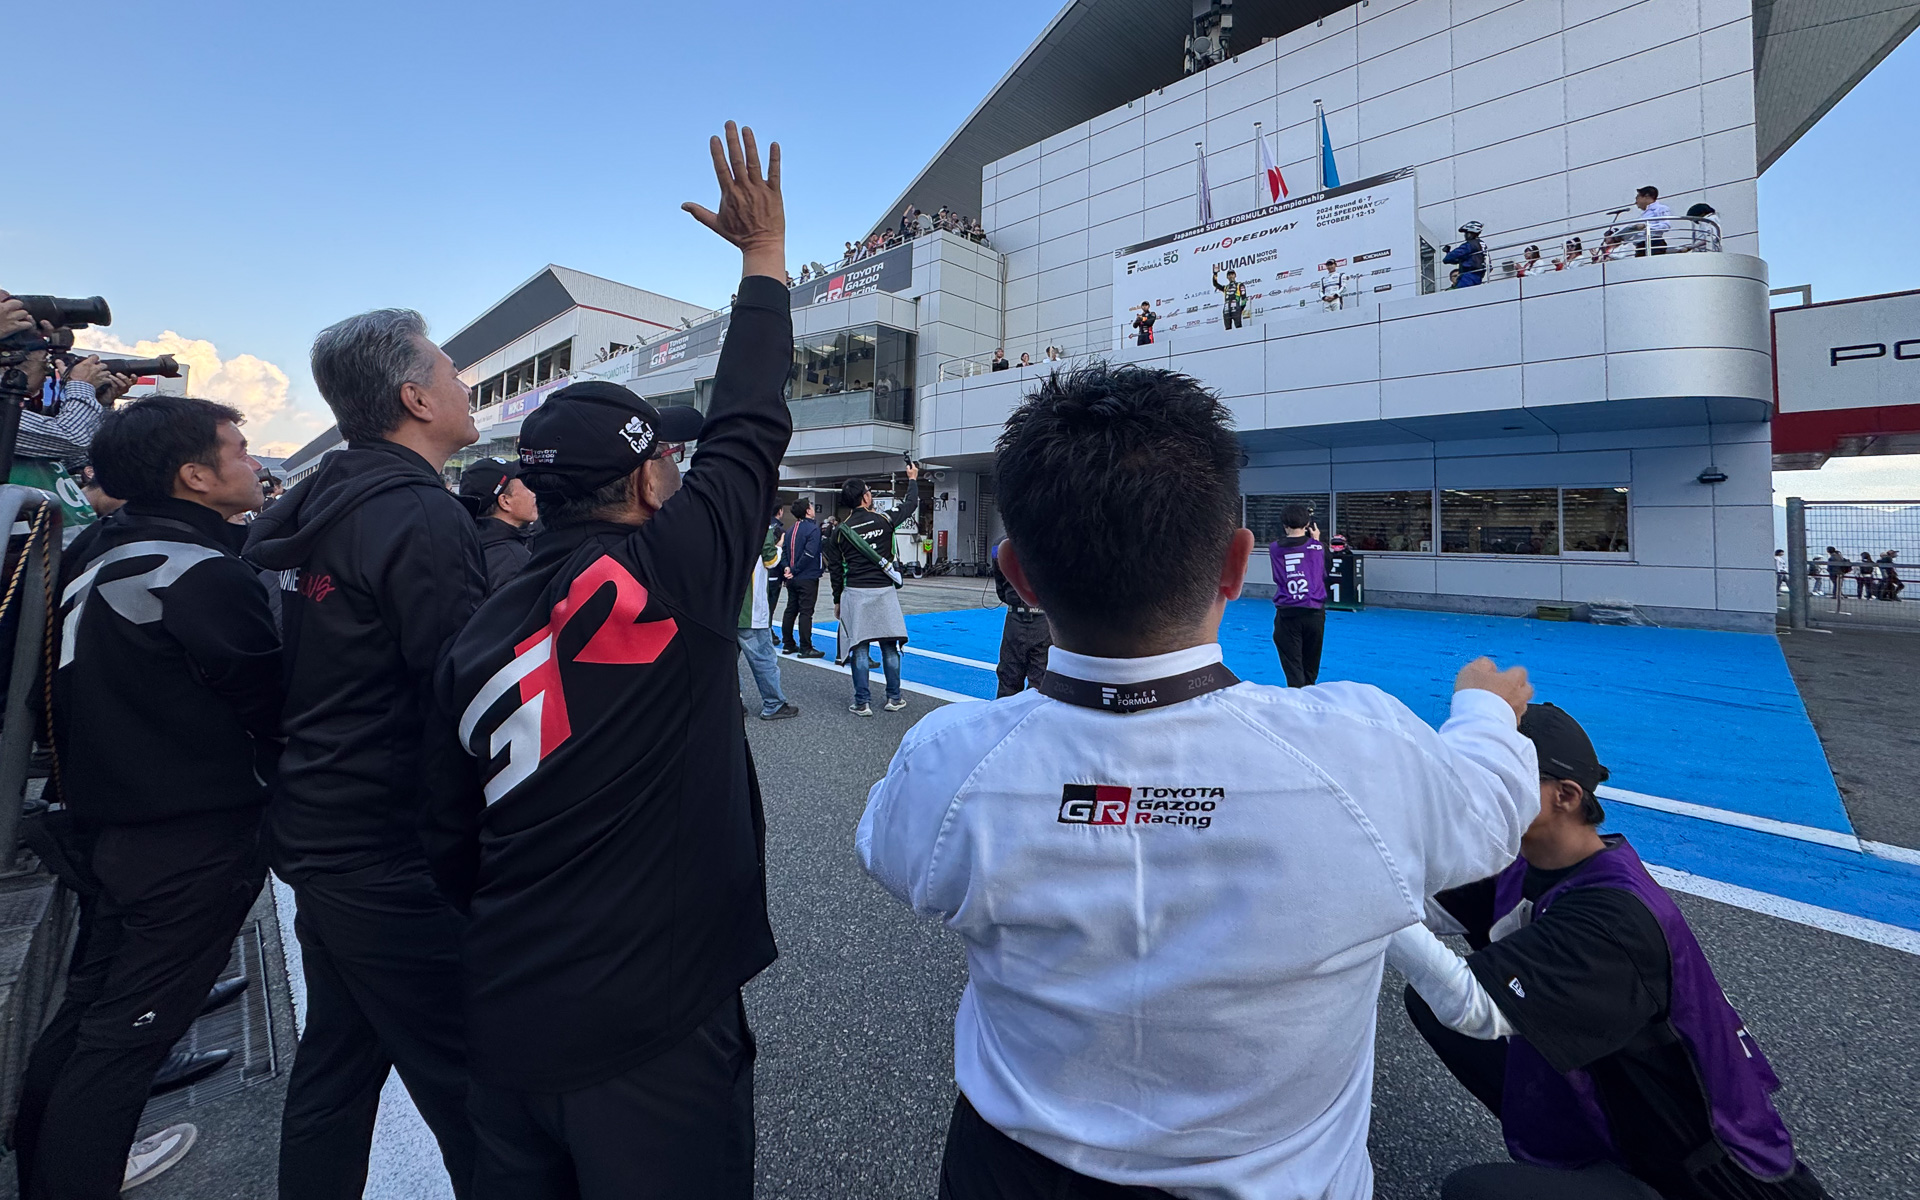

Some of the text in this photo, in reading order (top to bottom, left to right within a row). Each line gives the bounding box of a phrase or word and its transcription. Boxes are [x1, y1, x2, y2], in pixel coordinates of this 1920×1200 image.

[1316, 205, 1333, 215] 2024
[1334, 199, 1357, 210] Round
[1316, 202, 1373, 222] FUJI SPEEDWAY
[1173, 193, 1325, 241] Japanese SUPER FORMULA Championship
[1316, 214, 1350, 228] OCTOBER
[1355, 208, 1376, 218] 12-13
[1194, 242, 1220, 254] FUJI
[1256, 248, 1278, 258] MOTOR
[1136, 261, 1162, 273] FORMULA
[1163, 253, 1179, 266] 50
[1213, 253, 1256, 273] HUMAN
[1256, 254, 1278, 264] SPORTS
[847, 262, 884, 282] TOYOTA
[844, 273, 880, 292] GAZOO
[650, 335, 690, 366] GR TOYOTA
[667, 343, 688, 354] GAZOO
[630, 422, 654, 454] Cars!
[1287, 579, 1309, 595] 02
[1329, 583, 1340, 603] 1
[1356, 583, 1362, 603] 1
[458, 554, 679, 808] GR
[1053, 681, 1075, 696] 2024
[1187, 673, 1215, 690] 2024
[1117, 689, 1156, 700] SUPER
[1117, 695, 1157, 706] FORMULA
[1060, 787, 1226, 823] GR TOYOTA
[1136, 800, 1217, 812] GAZOO
[1134, 812, 1212, 829] Racing
